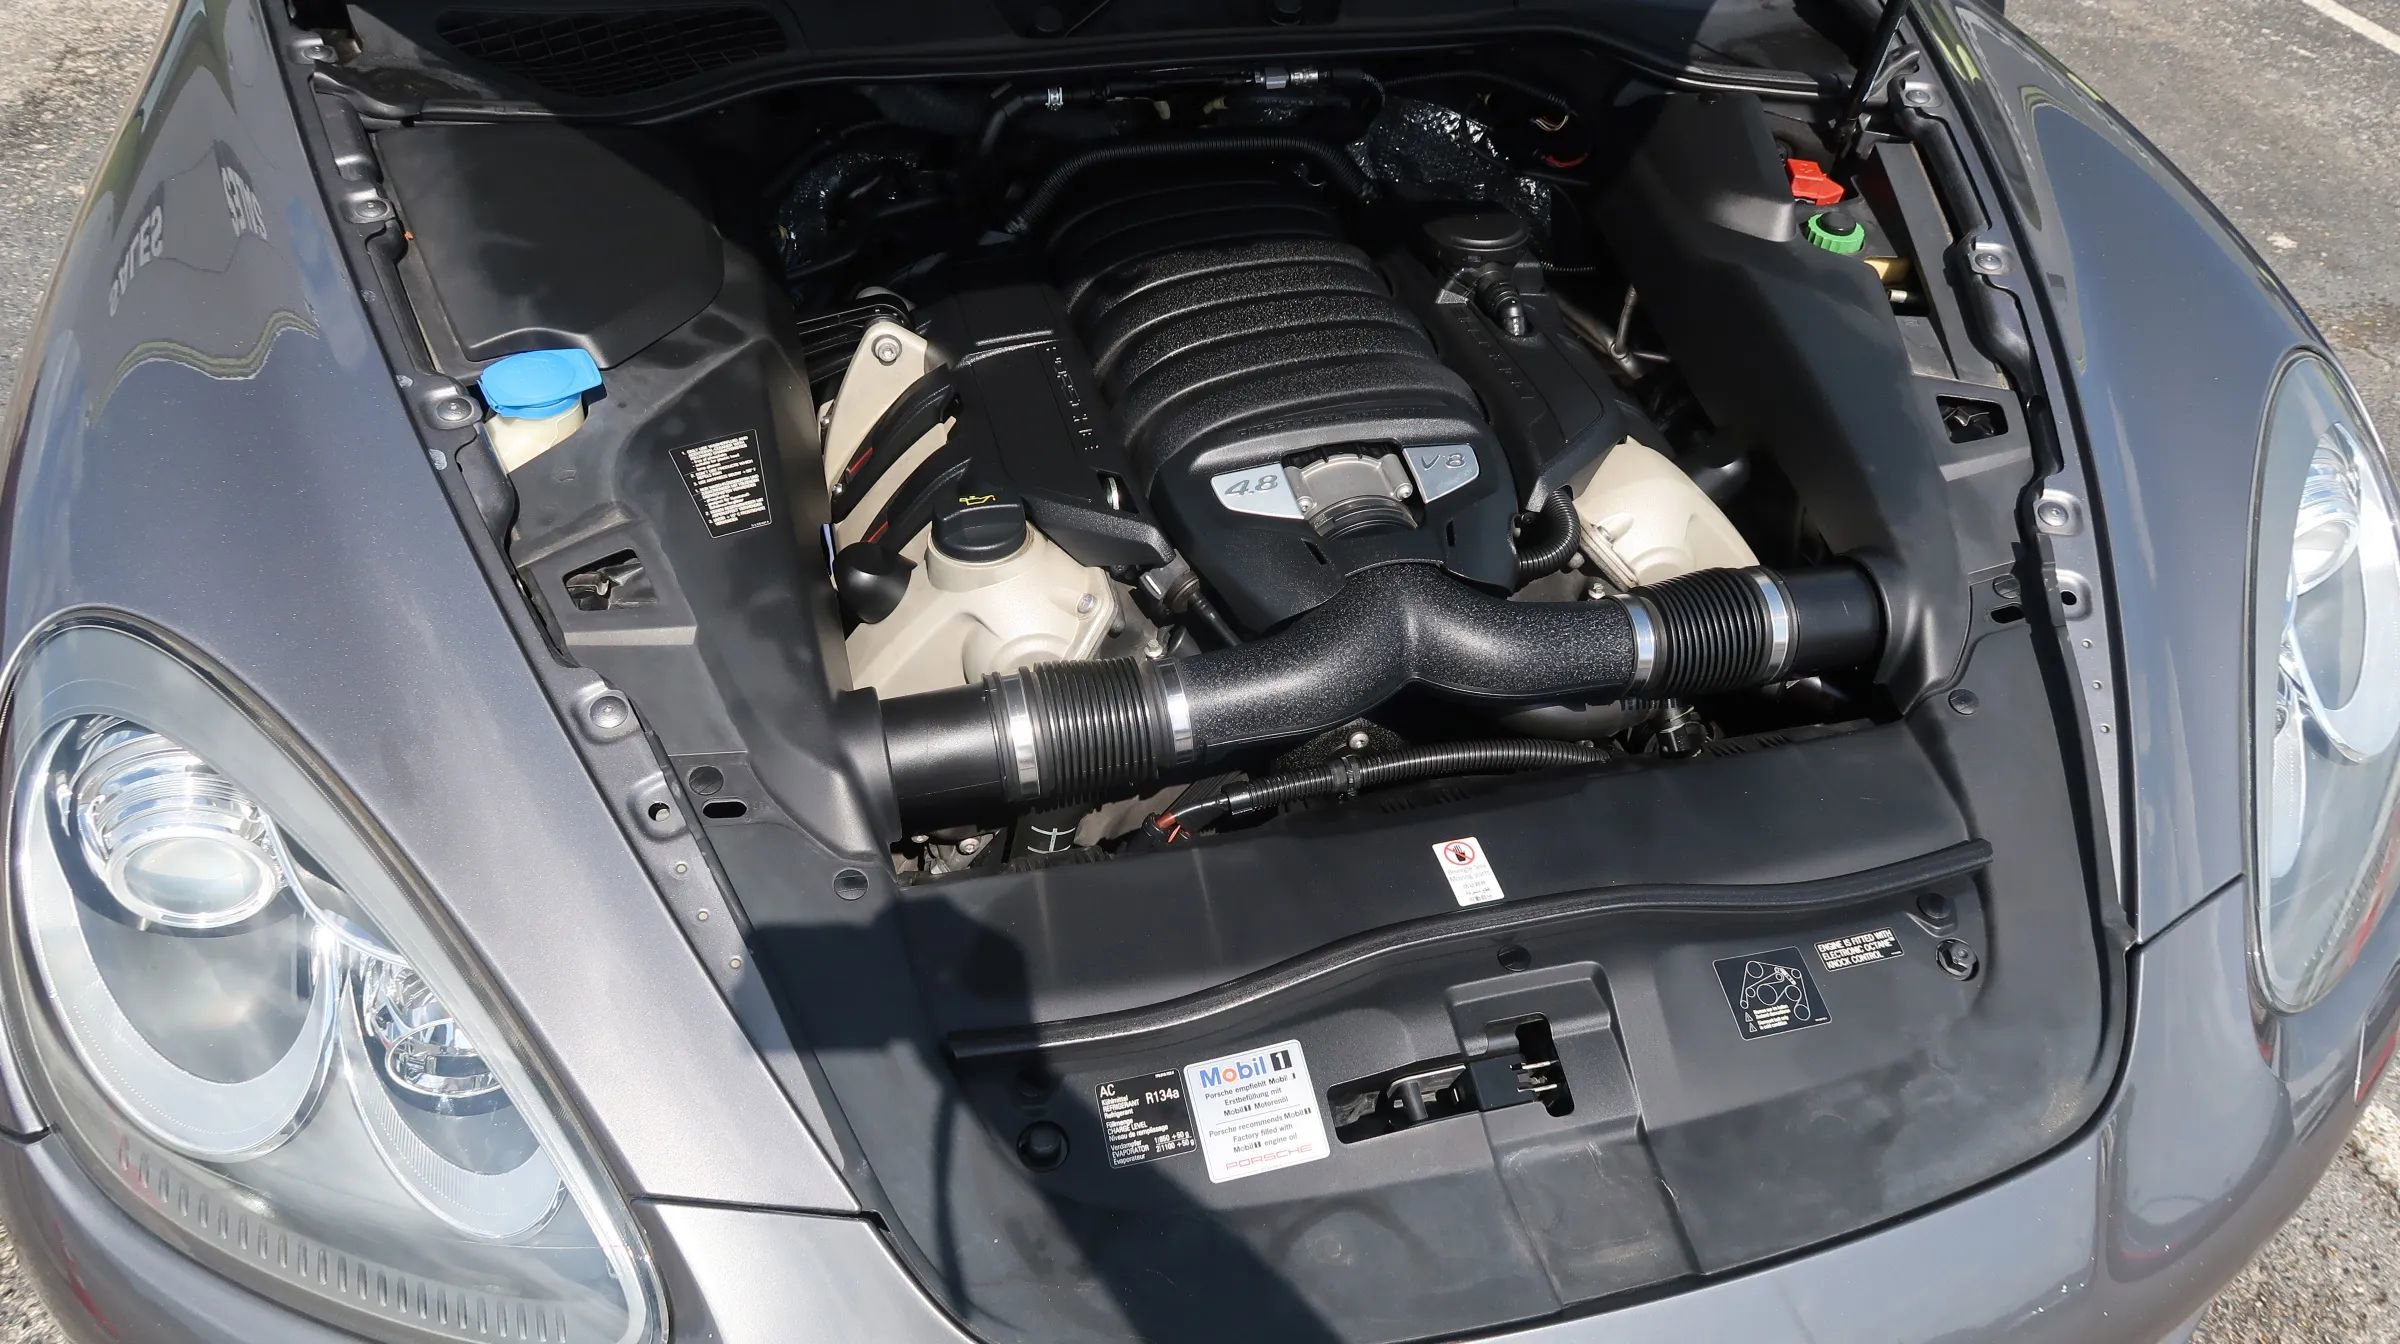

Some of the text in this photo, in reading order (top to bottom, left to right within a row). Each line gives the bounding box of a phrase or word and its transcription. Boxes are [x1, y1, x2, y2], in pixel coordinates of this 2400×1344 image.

[1224, 474, 1279, 496] 4.8
[1817, 929, 1893, 952] ENGINE IS FITTED WITH
[1821, 945, 1864, 961] ELECTRONIC
[1826, 950, 1884, 969] KNOCK CONTROL
[1199, 1050, 1289, 1088] Mobil 1
[1100, 1084, 1115, 1098] AC
[1145, 1088, 1180, 1104] R134a
[1204, 1089, 1233, 1100] Porsche
[1235, 1080, 1267, 1093] empfiehlt
[1268, 1075, 1287, 1085] Mobil
[1224, 1087, 1282, 1106] Erstbefüllung mit
[1102, 1099, 1139, 1112] REFRIGERANT
[1223, 1106, 1244, 1116] Mobil
[1254, 1096, 1288, 1109] Motorenöl
[1107, 1121, 1148, 1135] CHARGE LEVEL
[1209, 1126, 1237, 1138] Porsche
[1238, 1114, 1283, 1130] recommends
[1283, 1109, 1304, 1119] Mobil
[1233, 1123, 1293, 1143] Factory filled with
[1112, 1144, 1150, 1159] EVAPORATOR
[1233, 1143, 1254, 1153] Mobil
[1264, 1136, 1287, 1146] engine
[1288, 1132, 1298, 1140] oil
[1225, 1144, 1312, 1171] PORSCHE
